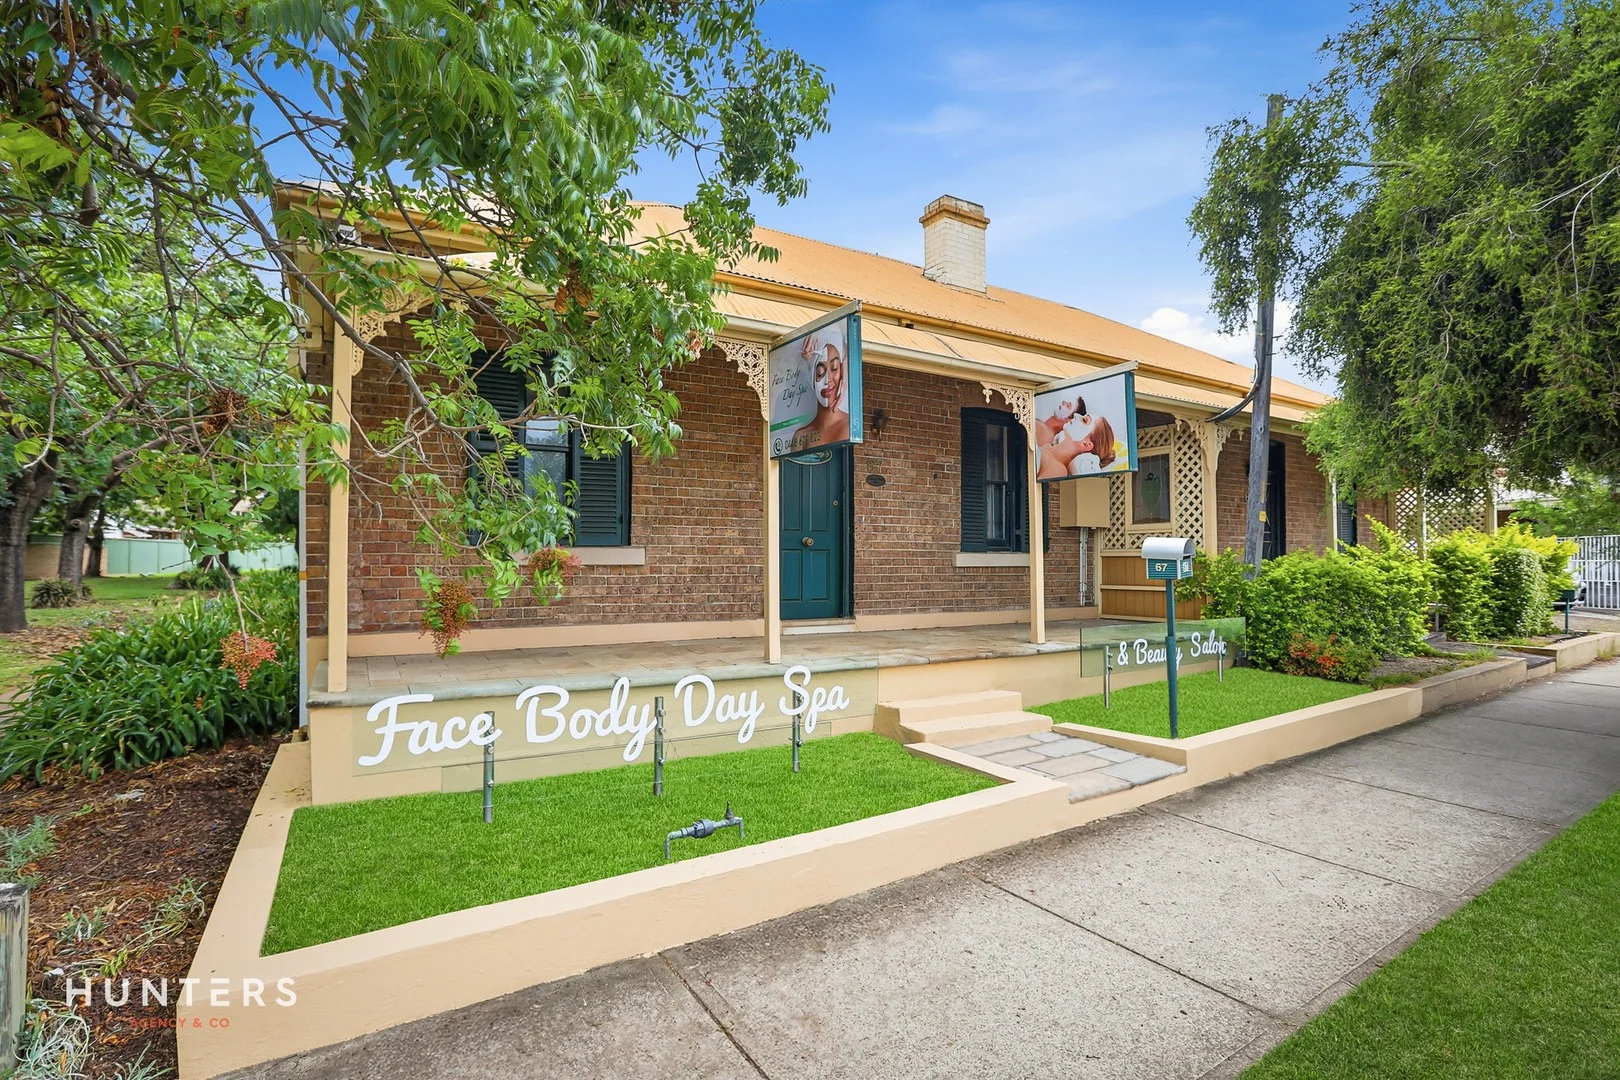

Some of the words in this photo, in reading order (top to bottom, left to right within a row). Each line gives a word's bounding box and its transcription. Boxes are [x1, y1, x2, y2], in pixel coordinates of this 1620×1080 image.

[782, 388, 795, 408] Day
[796, 383, 808, 407] Spa
[1155, 563, 1168, 572] 67
[1117, 640, 1129, 666] &
[1133, 638, 1183, 671] Beauy
[1190, 628, 1227, 658] Salon
[358, 693, 503, 767] Face
[515, 676, 658, 762] Body
[674, 674, 765, 744] Day
[778, 665, 850, 734] Spa
